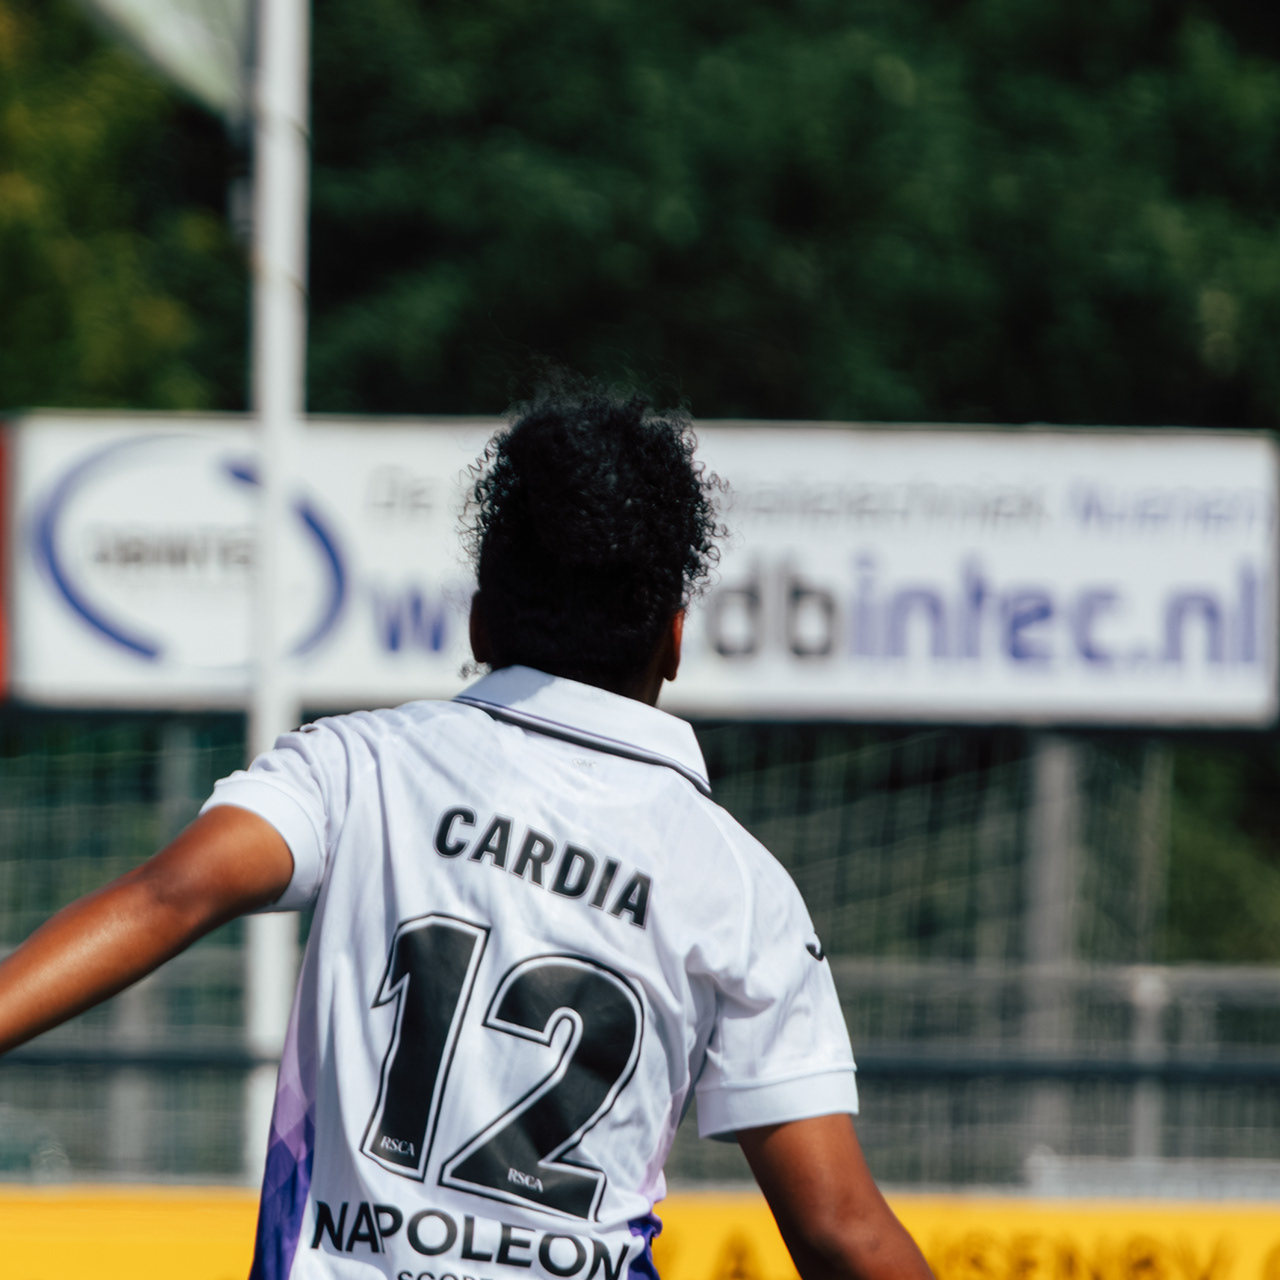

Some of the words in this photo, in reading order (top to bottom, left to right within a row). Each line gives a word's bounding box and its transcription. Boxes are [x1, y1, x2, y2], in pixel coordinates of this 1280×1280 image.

[433, 804, 653, 930] CARDIA
[361, 912, 644, 1222] 12
[380, 1135, 415, 1157] RSCA
[507, 1168, 544, 1193] RSCA
